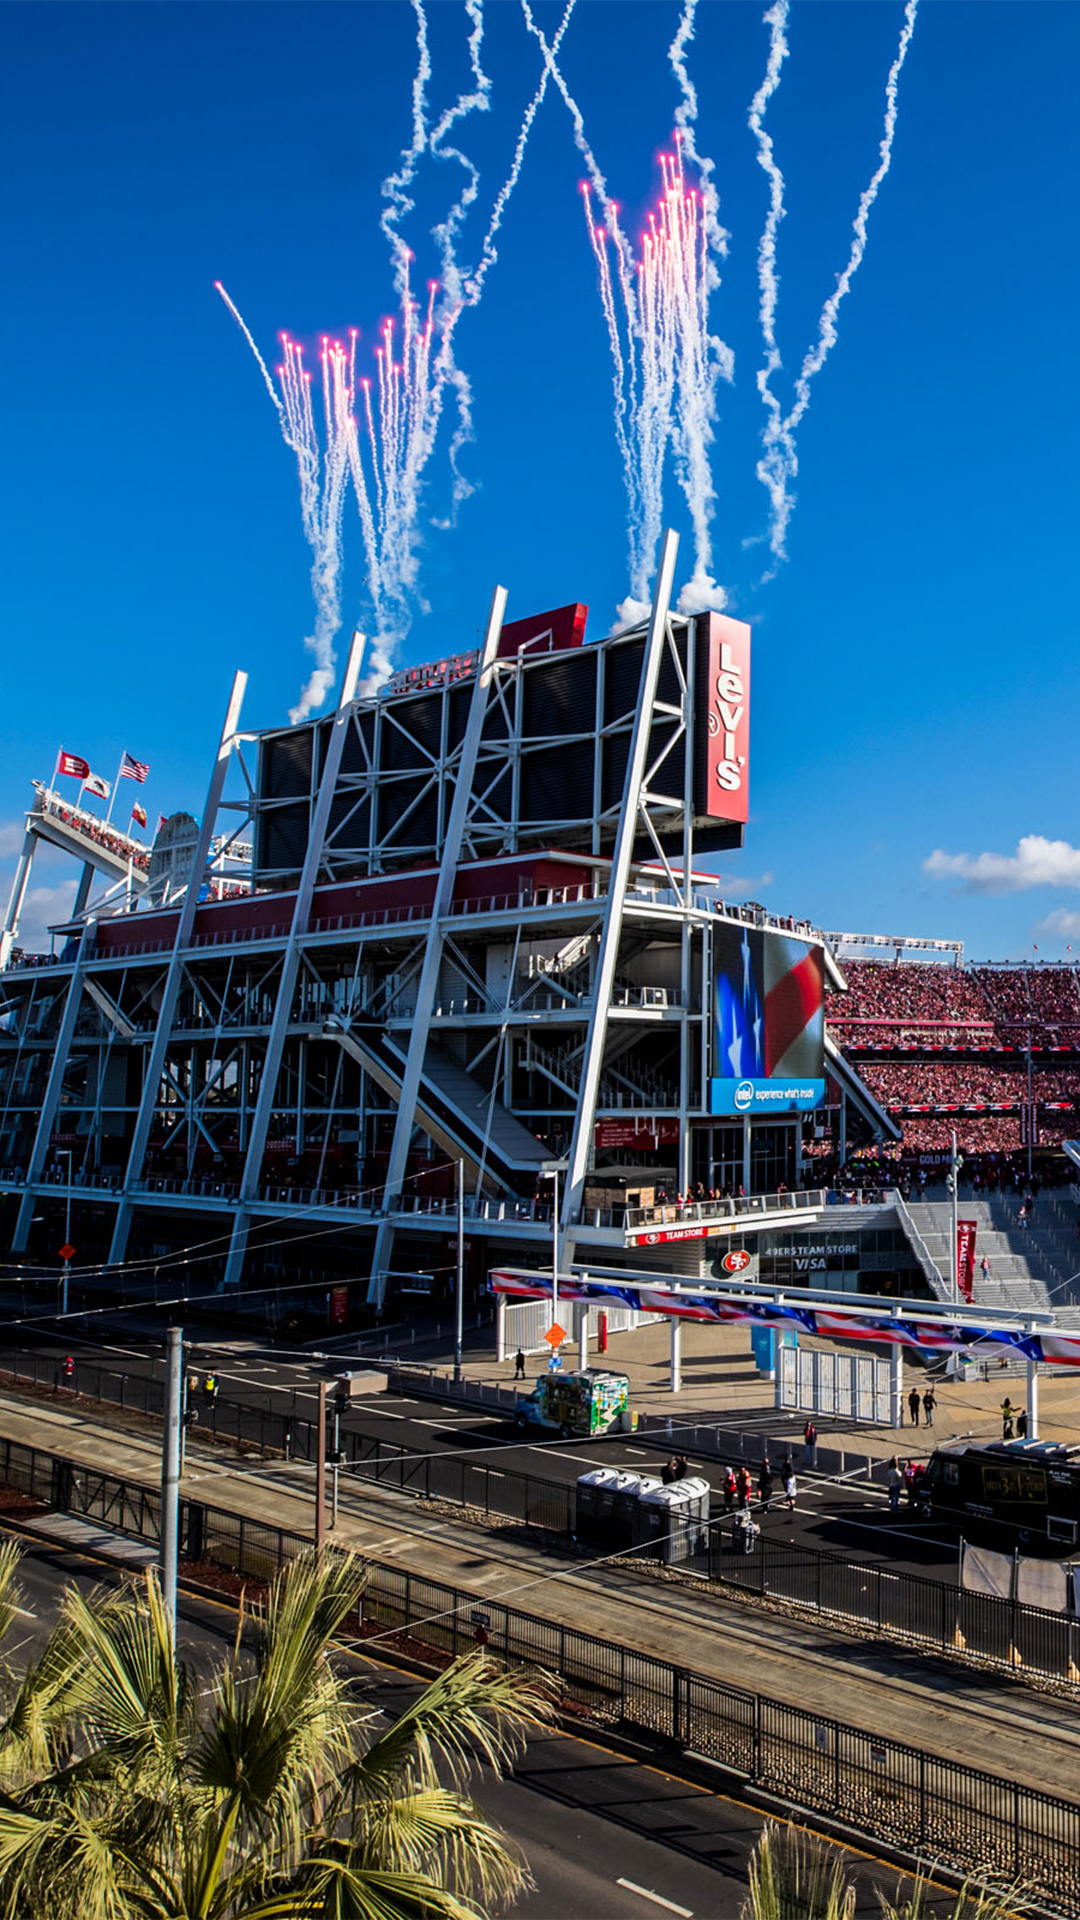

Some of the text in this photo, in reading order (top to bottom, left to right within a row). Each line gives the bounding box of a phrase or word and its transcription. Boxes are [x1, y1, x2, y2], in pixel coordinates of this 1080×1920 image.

[666, 1230, 684, 1240] TEAM
[684, 1228, 704, 1238] STORE
[765, 1244, 858, 1256] 49ERS TEAM STORE
[959, 1234, 969, 1262] TEAM
[794, 1258, 827, 1270] VISA
